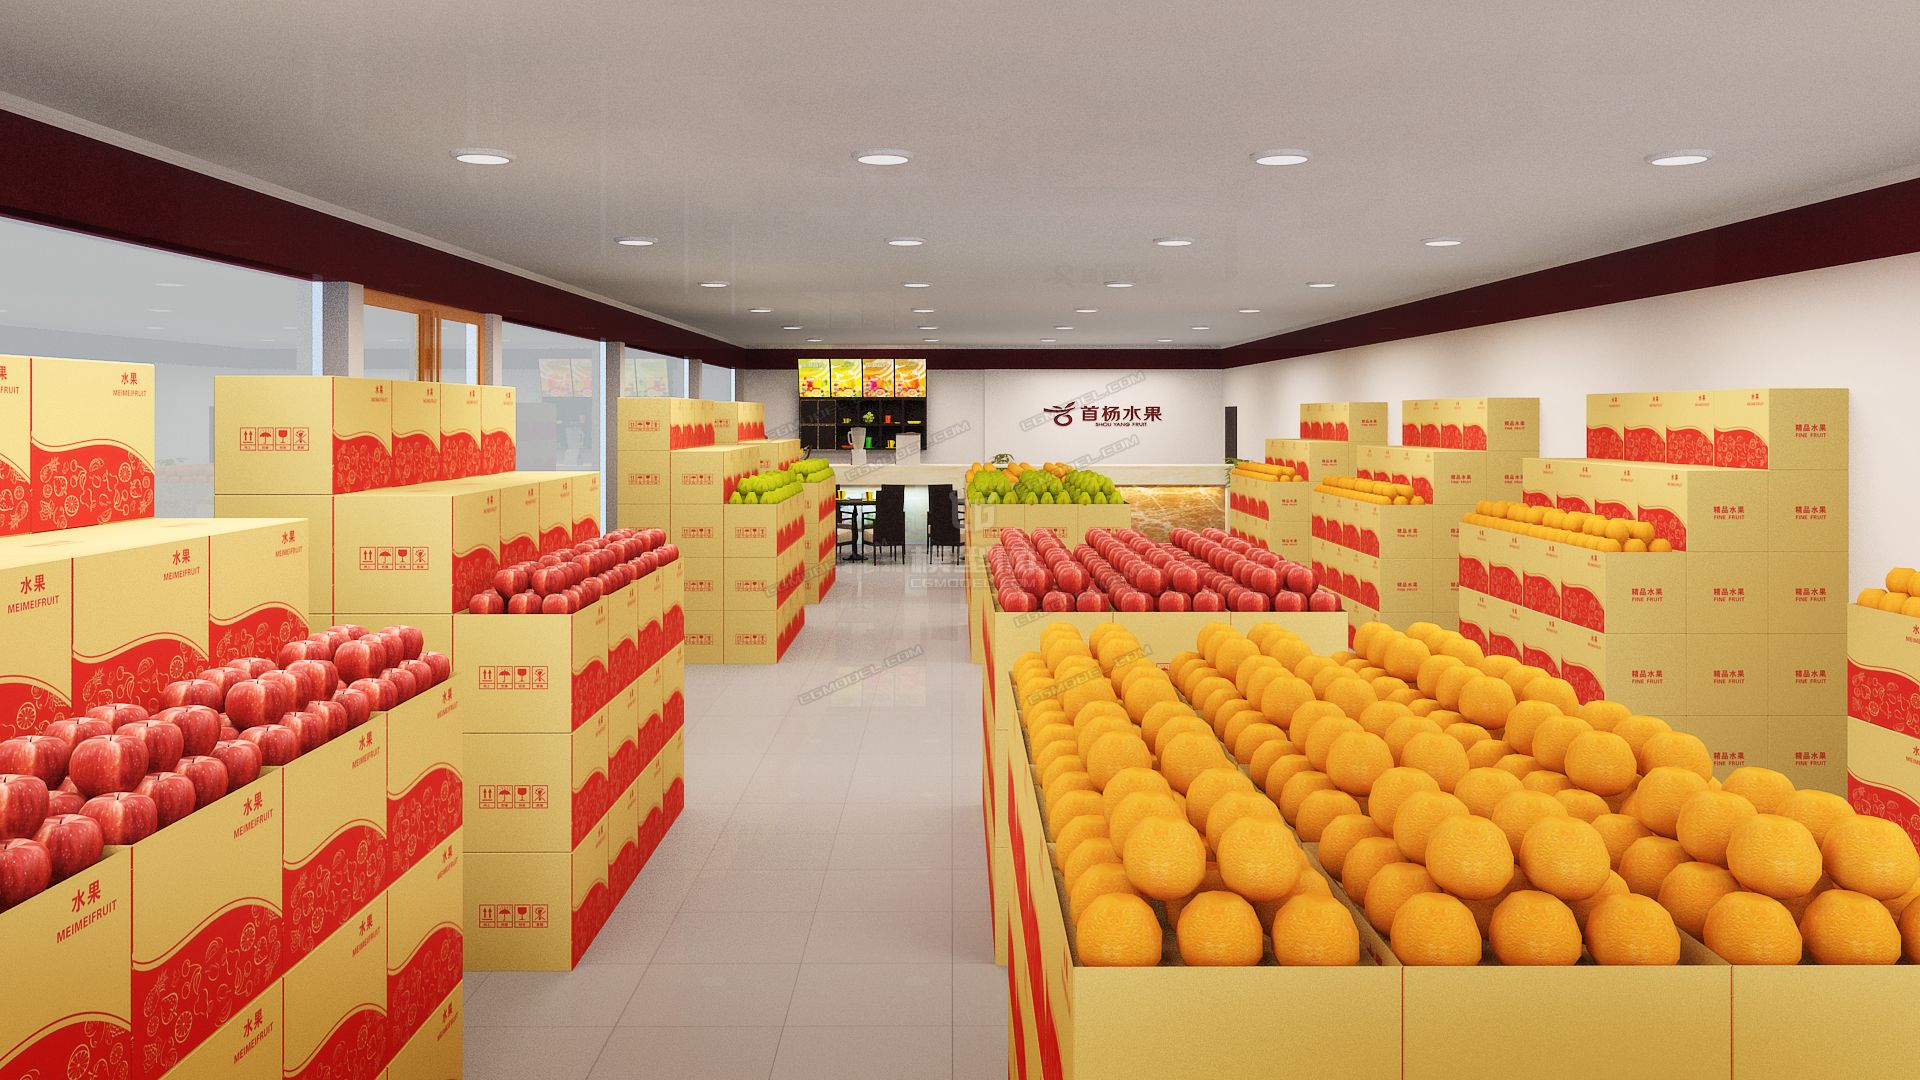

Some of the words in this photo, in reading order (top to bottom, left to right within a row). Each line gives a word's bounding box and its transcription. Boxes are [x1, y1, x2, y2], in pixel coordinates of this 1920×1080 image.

[121, 372, 138, 385] 水果
[1080, 405, 1163, 422] 首杨水果
[281, 530, 296, 544] 水果
[172, 548, 191, 566] 水果
[163, 566, 200, 581] MEIMEIFRUIT
[20, 574, 46, 595] 水果
[7, 594, 60, 614] MEIMEIFRUIT
[358, 731, 373, 751] 水果
[243, 791, 263, 817] 水果
[233, 808, 274, 840] MEIMEIFRUIT
[71, 879, 101, 913] 水果
[56, 898, 117, 944] MEIMEIFRUIT
[358, 913, 373, 936] 水果
[243, 1007, 263, 1038] 水果
[233, 1020, 274, 1064] MEIMEIFRUIT
